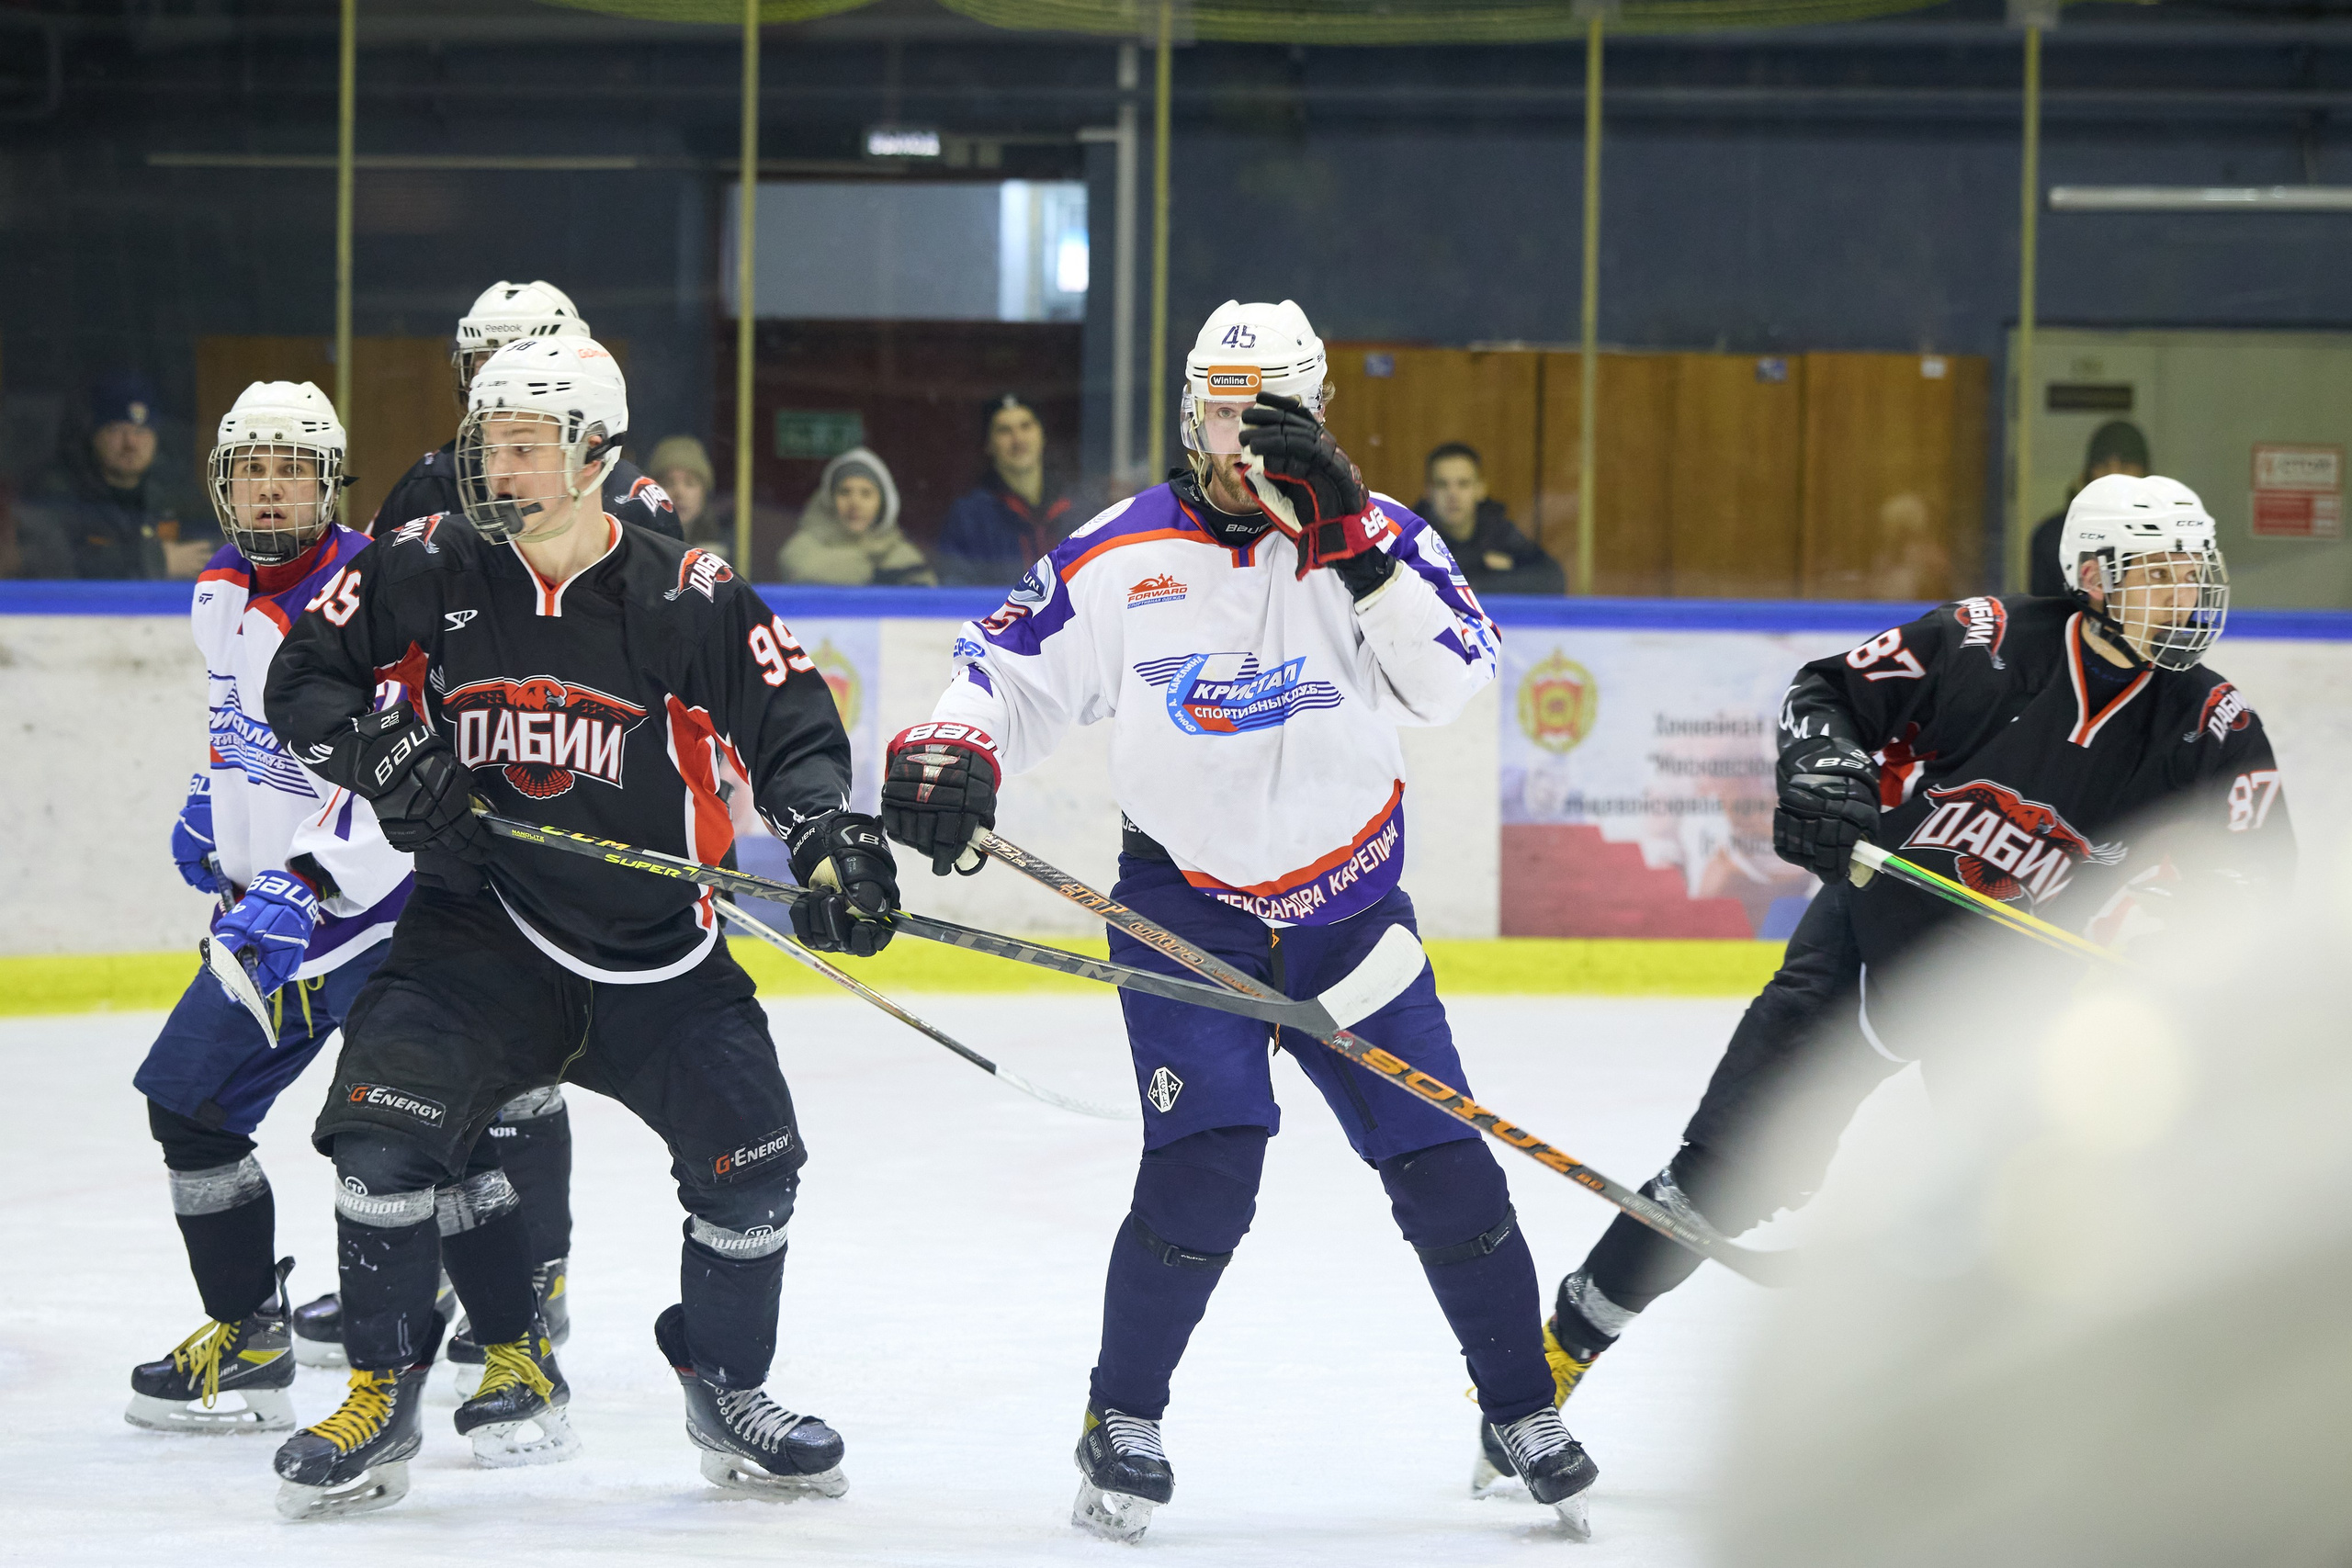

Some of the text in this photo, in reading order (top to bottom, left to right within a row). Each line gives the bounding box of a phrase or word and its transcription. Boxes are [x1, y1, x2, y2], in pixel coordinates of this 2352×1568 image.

[485, 324, 522, 333] Reebok
[1222, 325, 1256, 348] 45
[1214, 377, 1245, 385] Winline
[2079, 532, 2106, 540] CCM
[1127, 587, 1188, 603] FORWARD
[1846, 627, 1927, 682] 87
[1168, 655, 1206, 694] КАРЕЛИНА
[1193, 662, 1298, 702] КРИСТАЛ
[1283, 683, 1319, 708] КЛУБ
[2227, 770, 2281, 832] 87
[605, 853, 683, 879] SUPER
[1329, 819, 1399, 897] КАРЕЛИНА
[1159, 1070, 1169, 1108] TACKLA
[1361, 1047, 1582, 1174] SOYUZ
